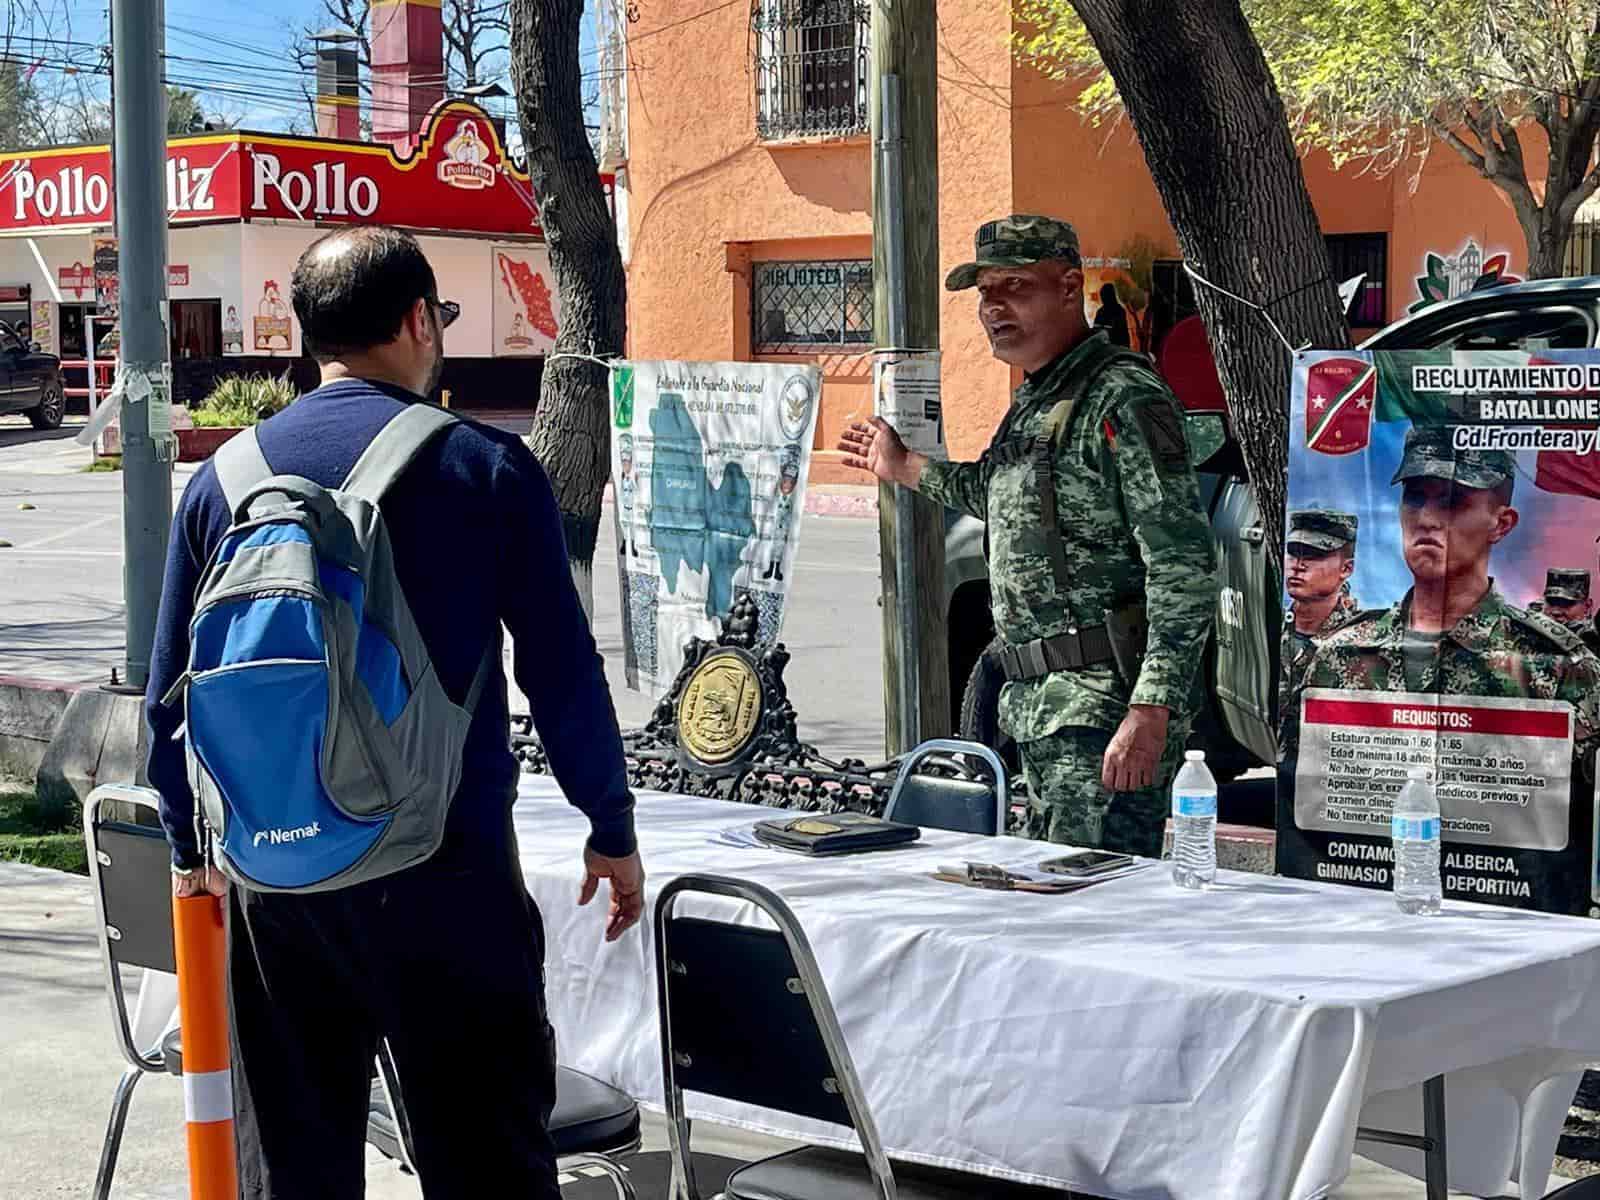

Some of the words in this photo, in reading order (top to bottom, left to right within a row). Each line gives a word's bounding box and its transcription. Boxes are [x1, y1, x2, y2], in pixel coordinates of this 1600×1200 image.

[14, 166, 108, 220] Pollo
[167, 157, 214, 211] liz
[251, 153, 379, 217] Pollo
[760, 267, 841, 287] BIBLIOTECA
[731, 376, 764, 393] Nacional
[1415, 368, 1582, 389] RECLUTAMIENTO
[1579, 432, 1593, 452] y
[1393, 709, 1473, 727] REQUISITOS:
[1331, 732, 1370, 744] Estatura
[1331, 747, 1354, 759] Edad
[1484, 757, 1497, 769] 30
[1499, 758, 1524, 770] años
[1329, 763, 1340, 773] No
[1344, 765, 1371, 775] haber
[1459, 771, 1497, 784] fuerzas
[1500, 776, 1545, 788] armadas
[1328, 779, 1368, 791] Aprobar
[1370, 783, 1383, 792] los
[1481, 790, 1518, 802] previos
[1521, 793, 1529, 804] y
[1328, 796, 1366, 807] examen
[1328, 809, 1340, 820] No
[1342, 810, 1368, 821] tener
[270, 821, 321, 845] Nemak
[1445, 852, 1519, 877] ALBERCA,
[1317, 862, 1388, 884] GIMNASIO
[1446, 875, 1532, 897] DEPORTIVA
